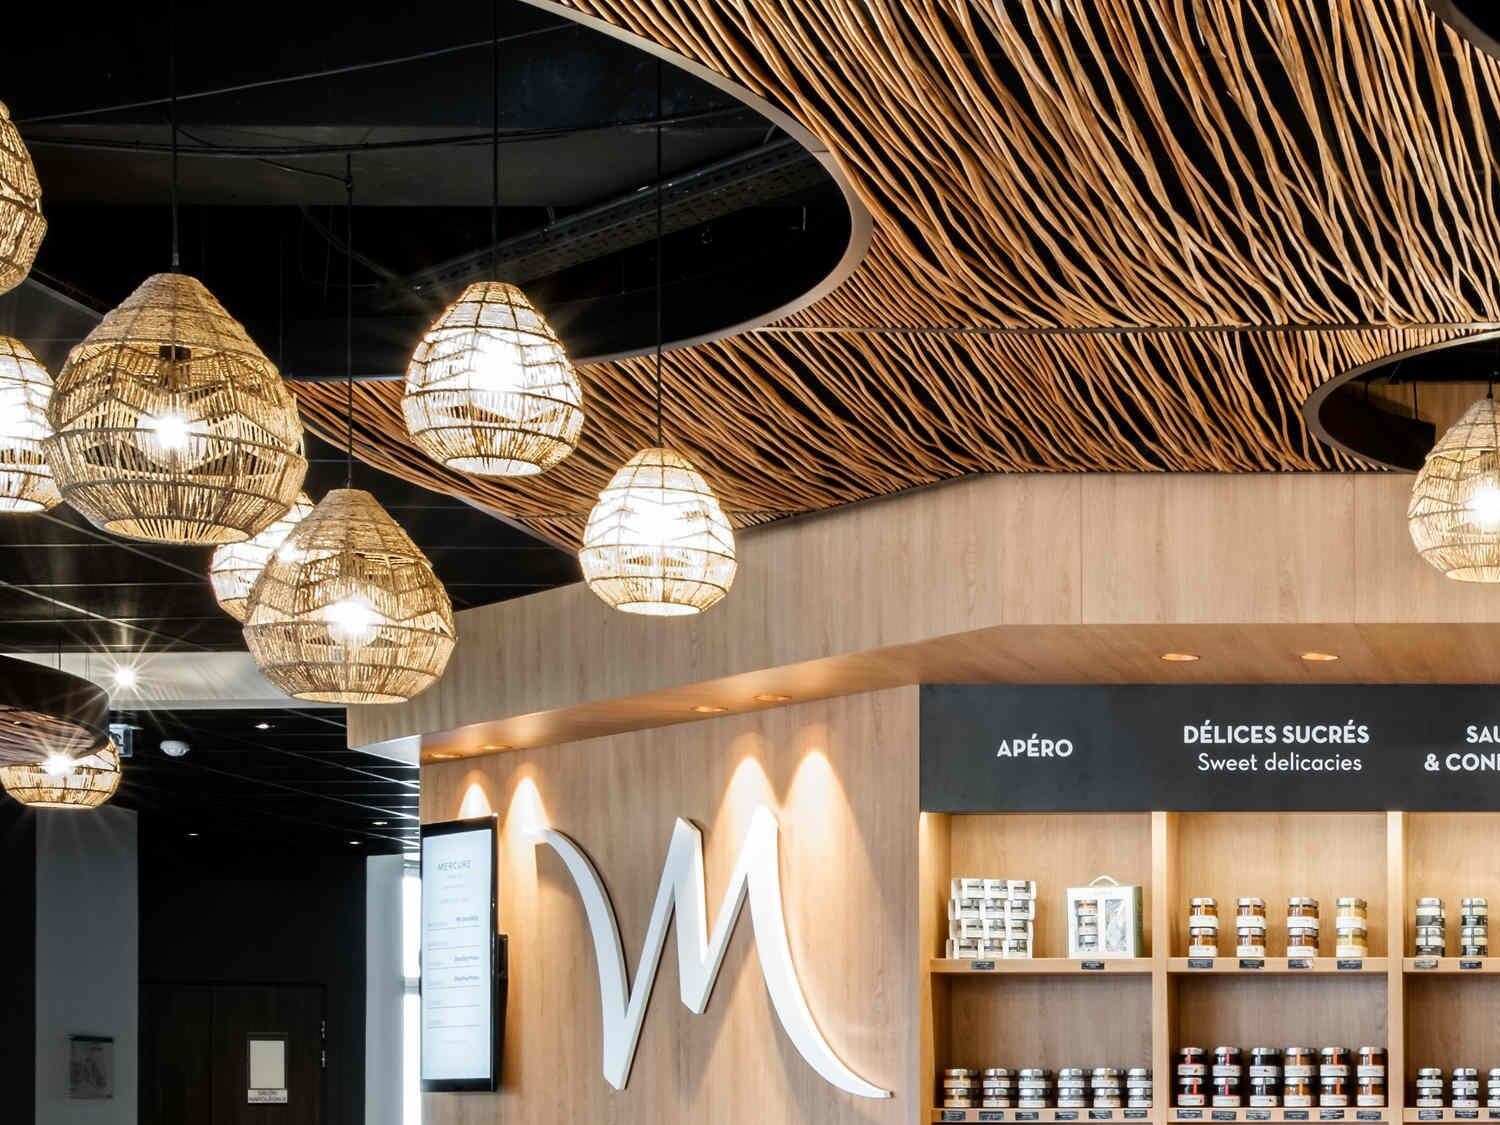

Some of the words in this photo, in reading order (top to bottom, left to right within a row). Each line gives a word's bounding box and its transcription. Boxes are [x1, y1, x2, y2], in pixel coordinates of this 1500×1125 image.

[1183, 719, 1277, 744] DÉLICES
[1281, 719, 1370, 744] SUCRÉS
[996, 732, 1074, 758] APÉRO
[1197, 752, 1258, 772] Sweet
[1264, 751, 1363, 771] delicacies
[1423, 752, 1441, 772] &
